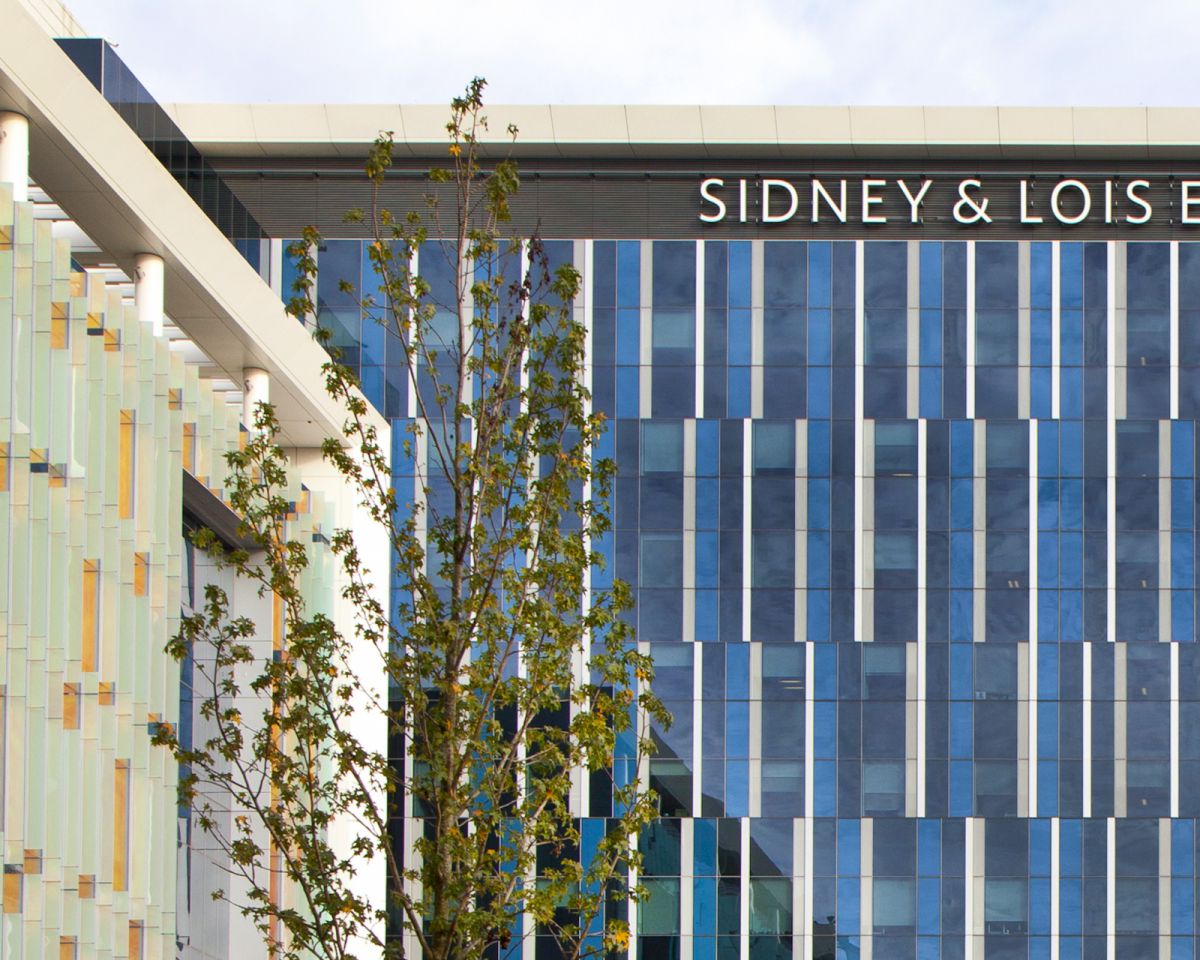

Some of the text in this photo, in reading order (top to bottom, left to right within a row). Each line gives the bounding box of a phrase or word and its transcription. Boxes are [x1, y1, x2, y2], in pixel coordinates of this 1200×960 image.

[699, 178, 932, 223] SIDNEY
[952, 179, 993, 223] &
[1020, 179, 1152, 224] LOIS
